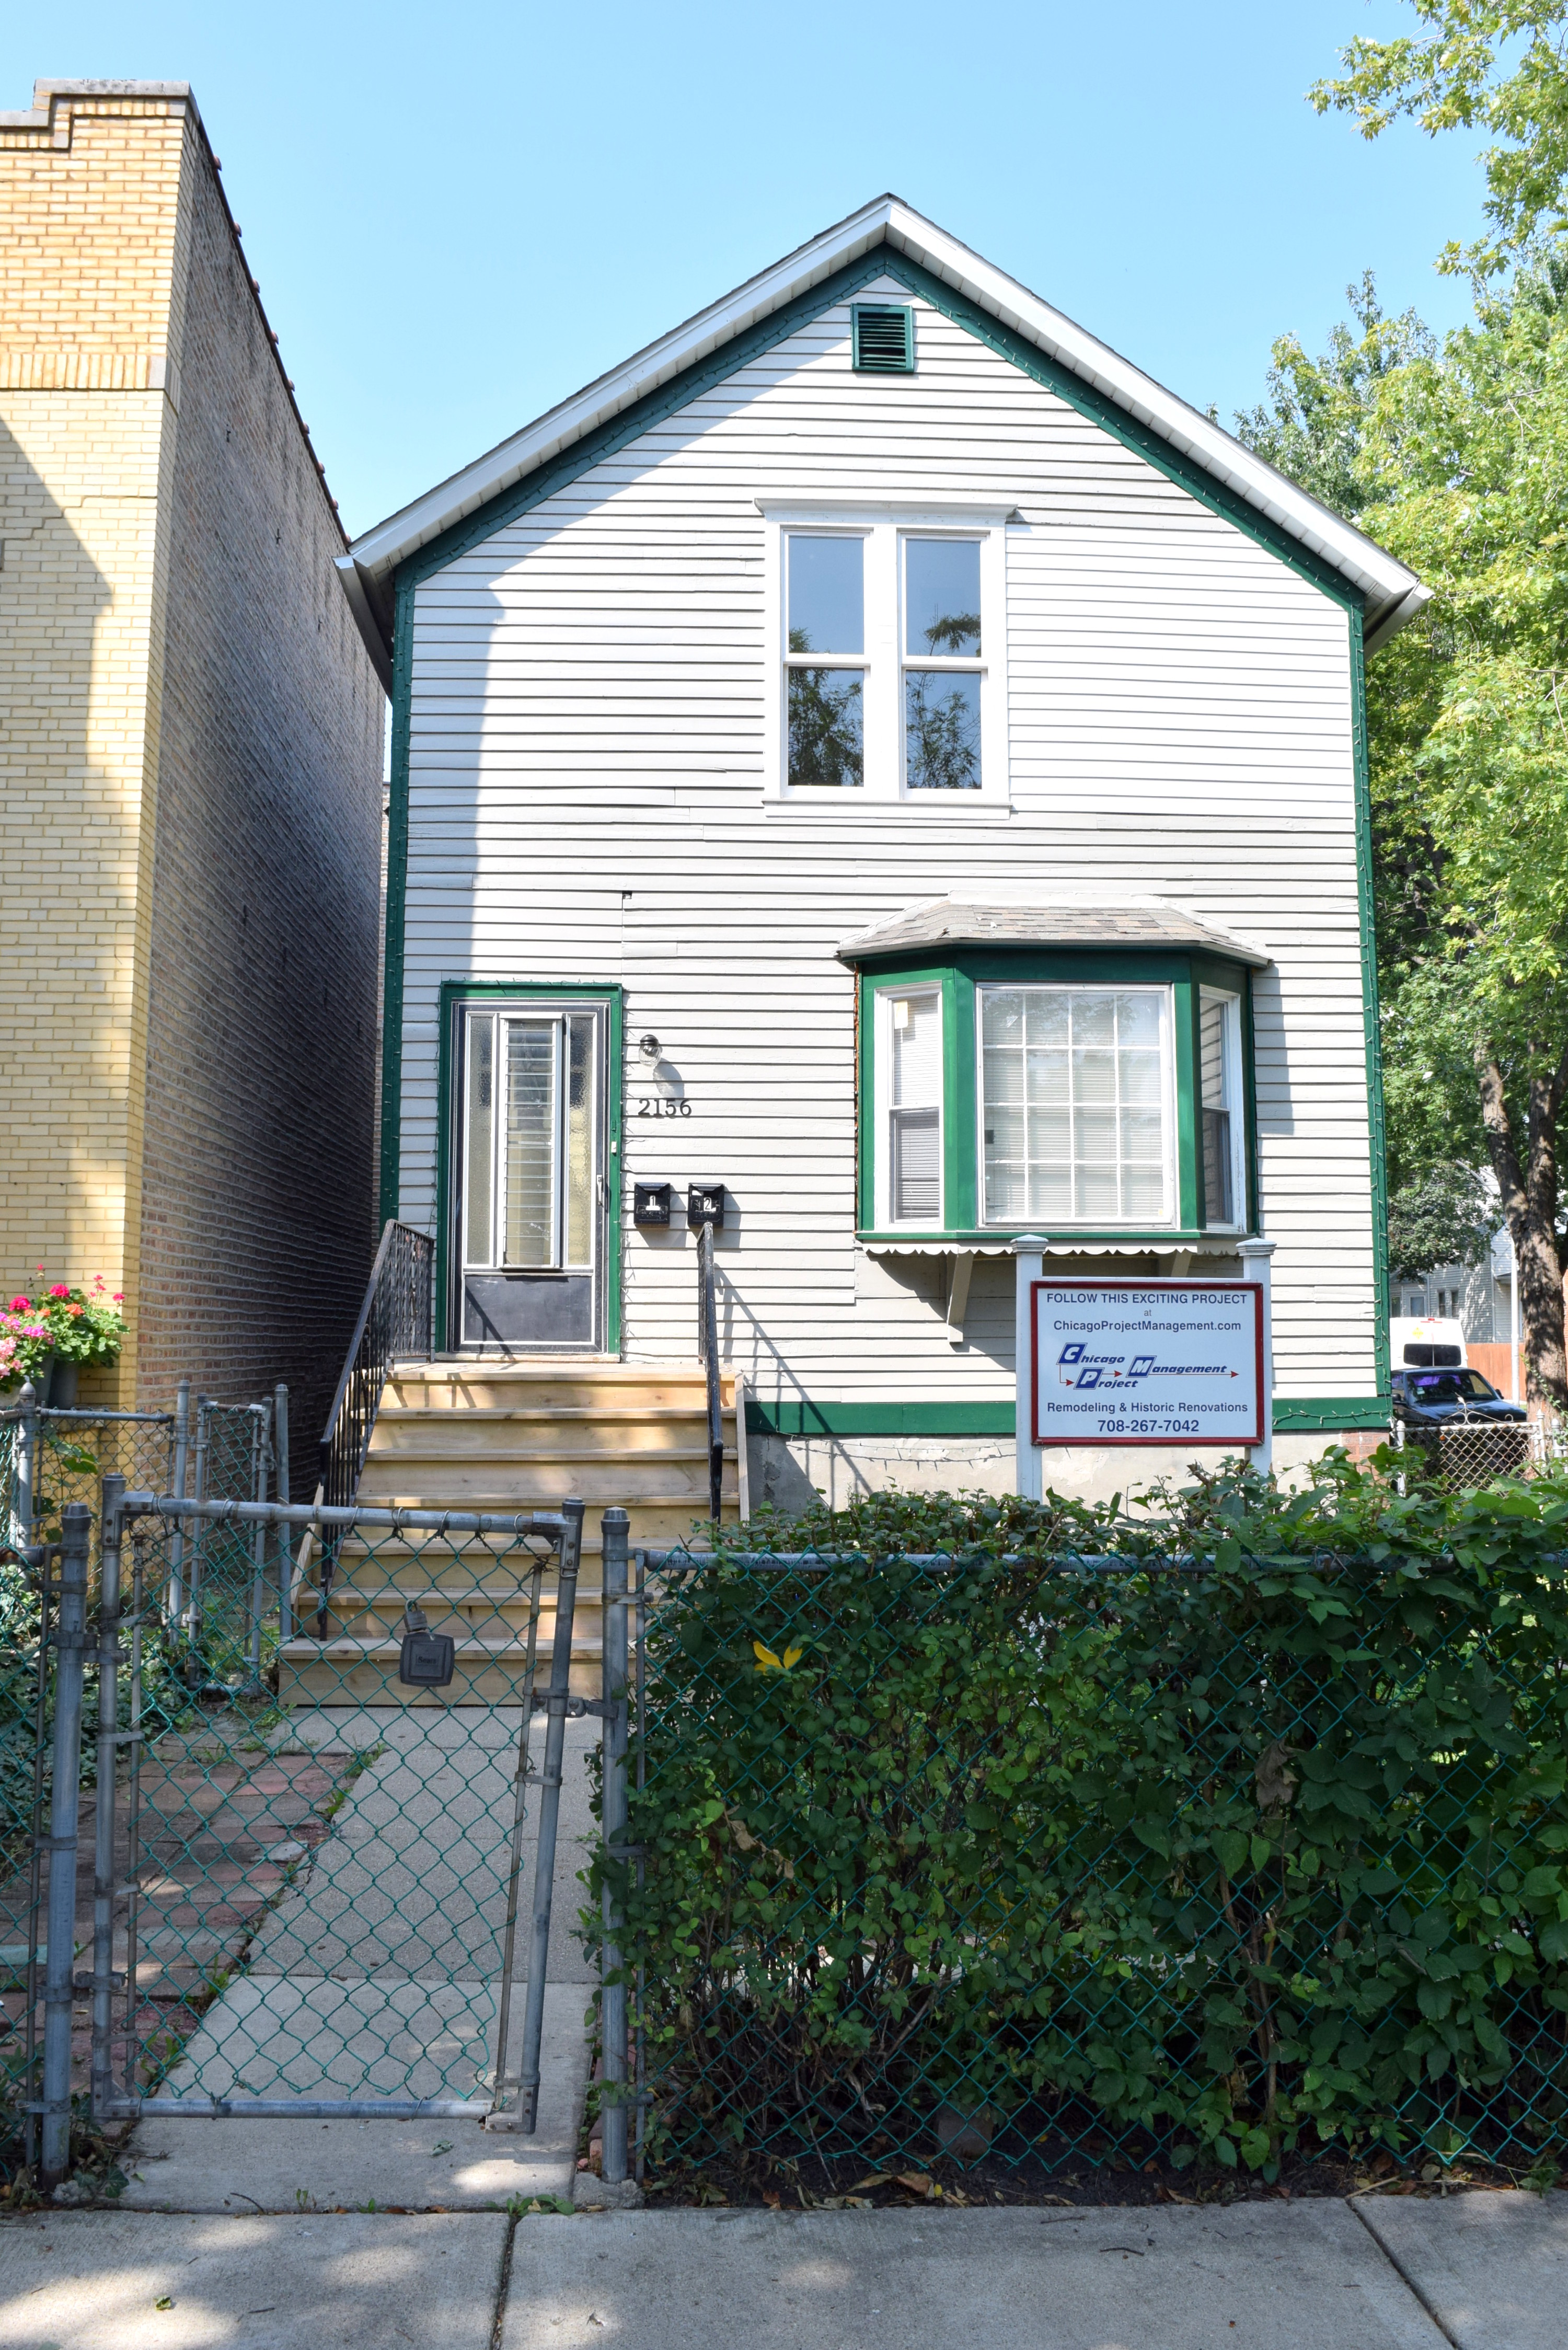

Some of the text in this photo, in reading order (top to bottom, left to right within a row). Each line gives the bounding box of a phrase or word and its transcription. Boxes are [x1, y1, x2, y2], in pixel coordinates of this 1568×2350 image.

[638, 1098, 692, 1117] 2156
[704, 1197, 711, 1210] 2
[1047, 1293, 1247, 1304] FOLLOW THIS EXCITING PROJECT
[1054, 1320, 1241, 1333] ChicagoProjectManagement.com
[1063, 1346, 1125, 1364] Chicago
[1129, 1359, 1227, 1375] Management
[1079, 1370, 1138, 1389] Project
[1047, 1402, 1248, 1414] Remodeling & Historic Renovations
[1097, 1419, 1200, 1432] 708-267-7042
